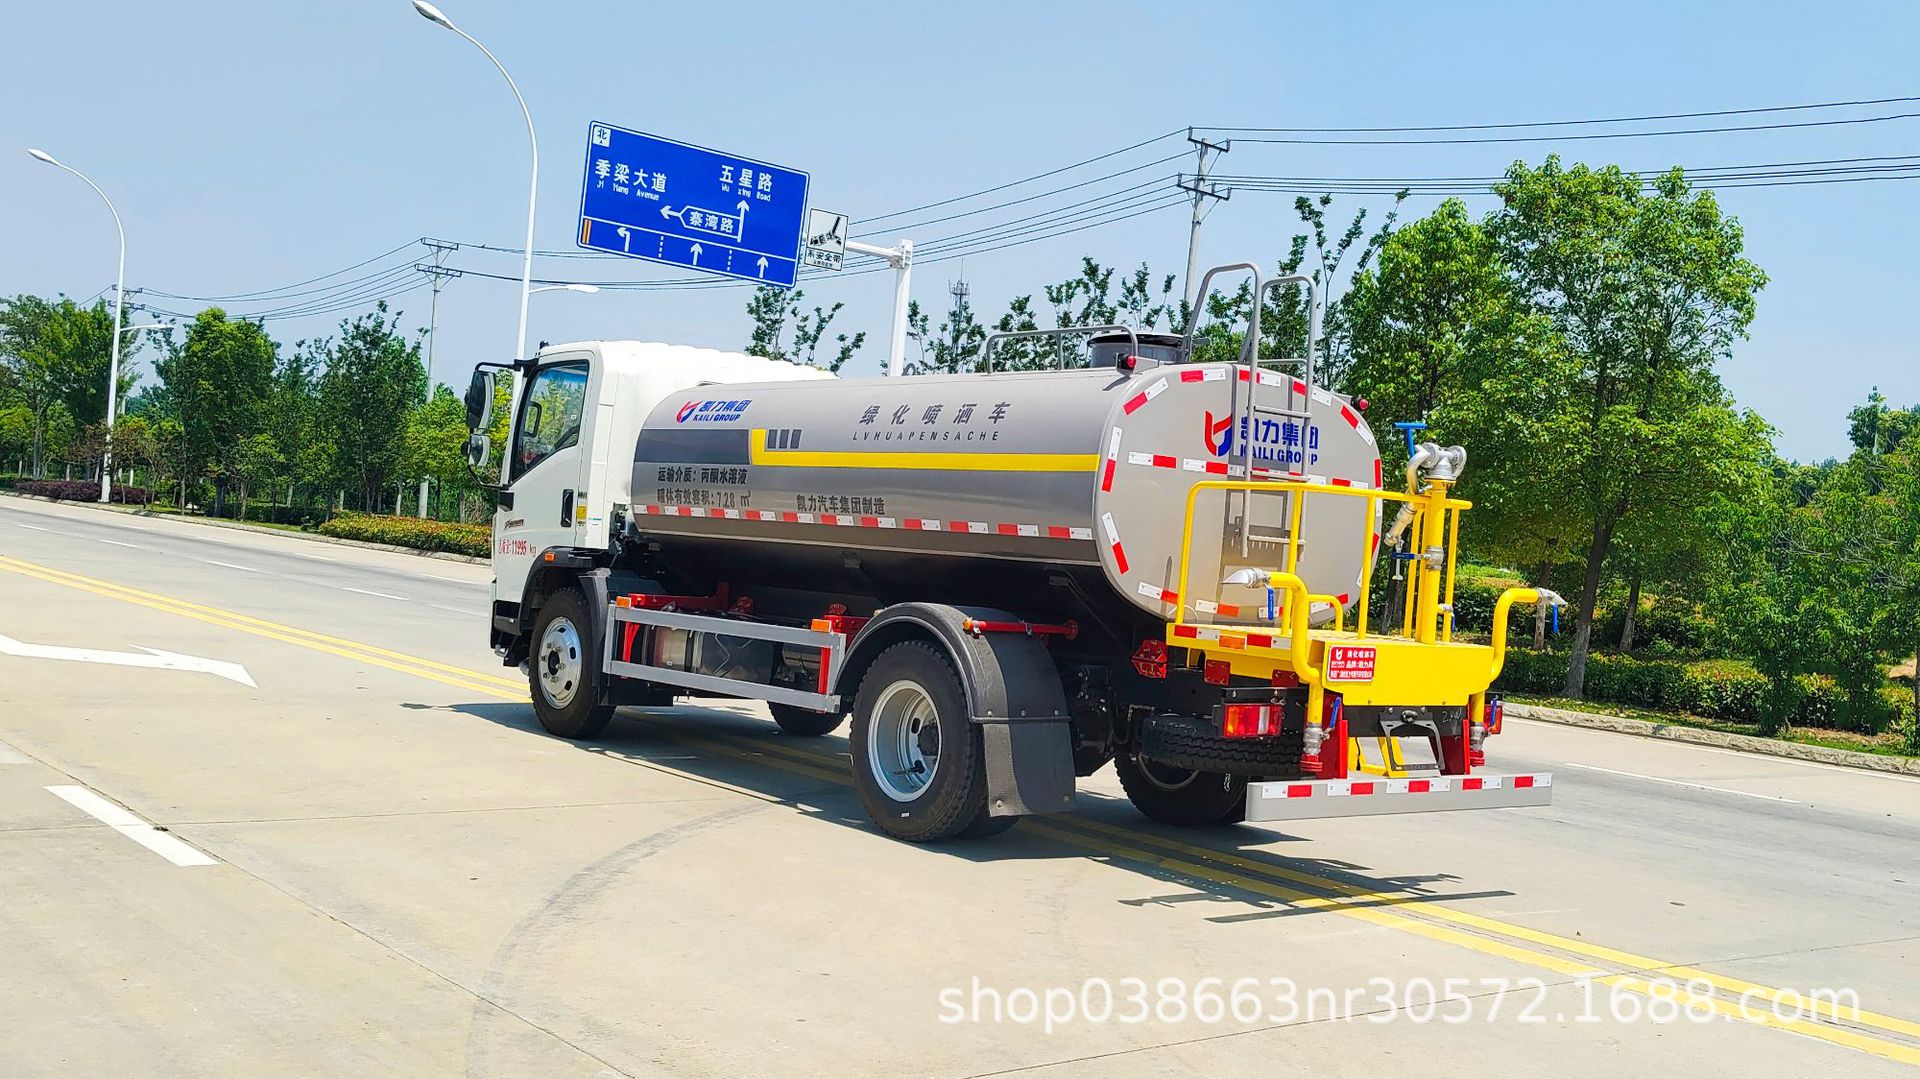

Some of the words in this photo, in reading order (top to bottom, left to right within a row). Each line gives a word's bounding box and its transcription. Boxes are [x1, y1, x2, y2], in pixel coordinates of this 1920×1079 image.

[596, 127, 608, 140] 北
[595, 159, 667, 193] 季梁大道
[719, 164, 772, 192] 五星路
[635, 188, 660, 201] Avenue
[756, 191, 771, 202] Road
[699, 399, 752, 412] 凯力集团
[692, 414, 713, 422] KAILI
[714, 414, 741, 422] GROUP
[859, 402, 1011, 425] 绿化喷洒车
[853, 430, 1000, 442] LVHUAPENSACHE
[1277, 449, 1318, 466] GROP
[796, 495, 885, 515] 凯力汽车集团制造
